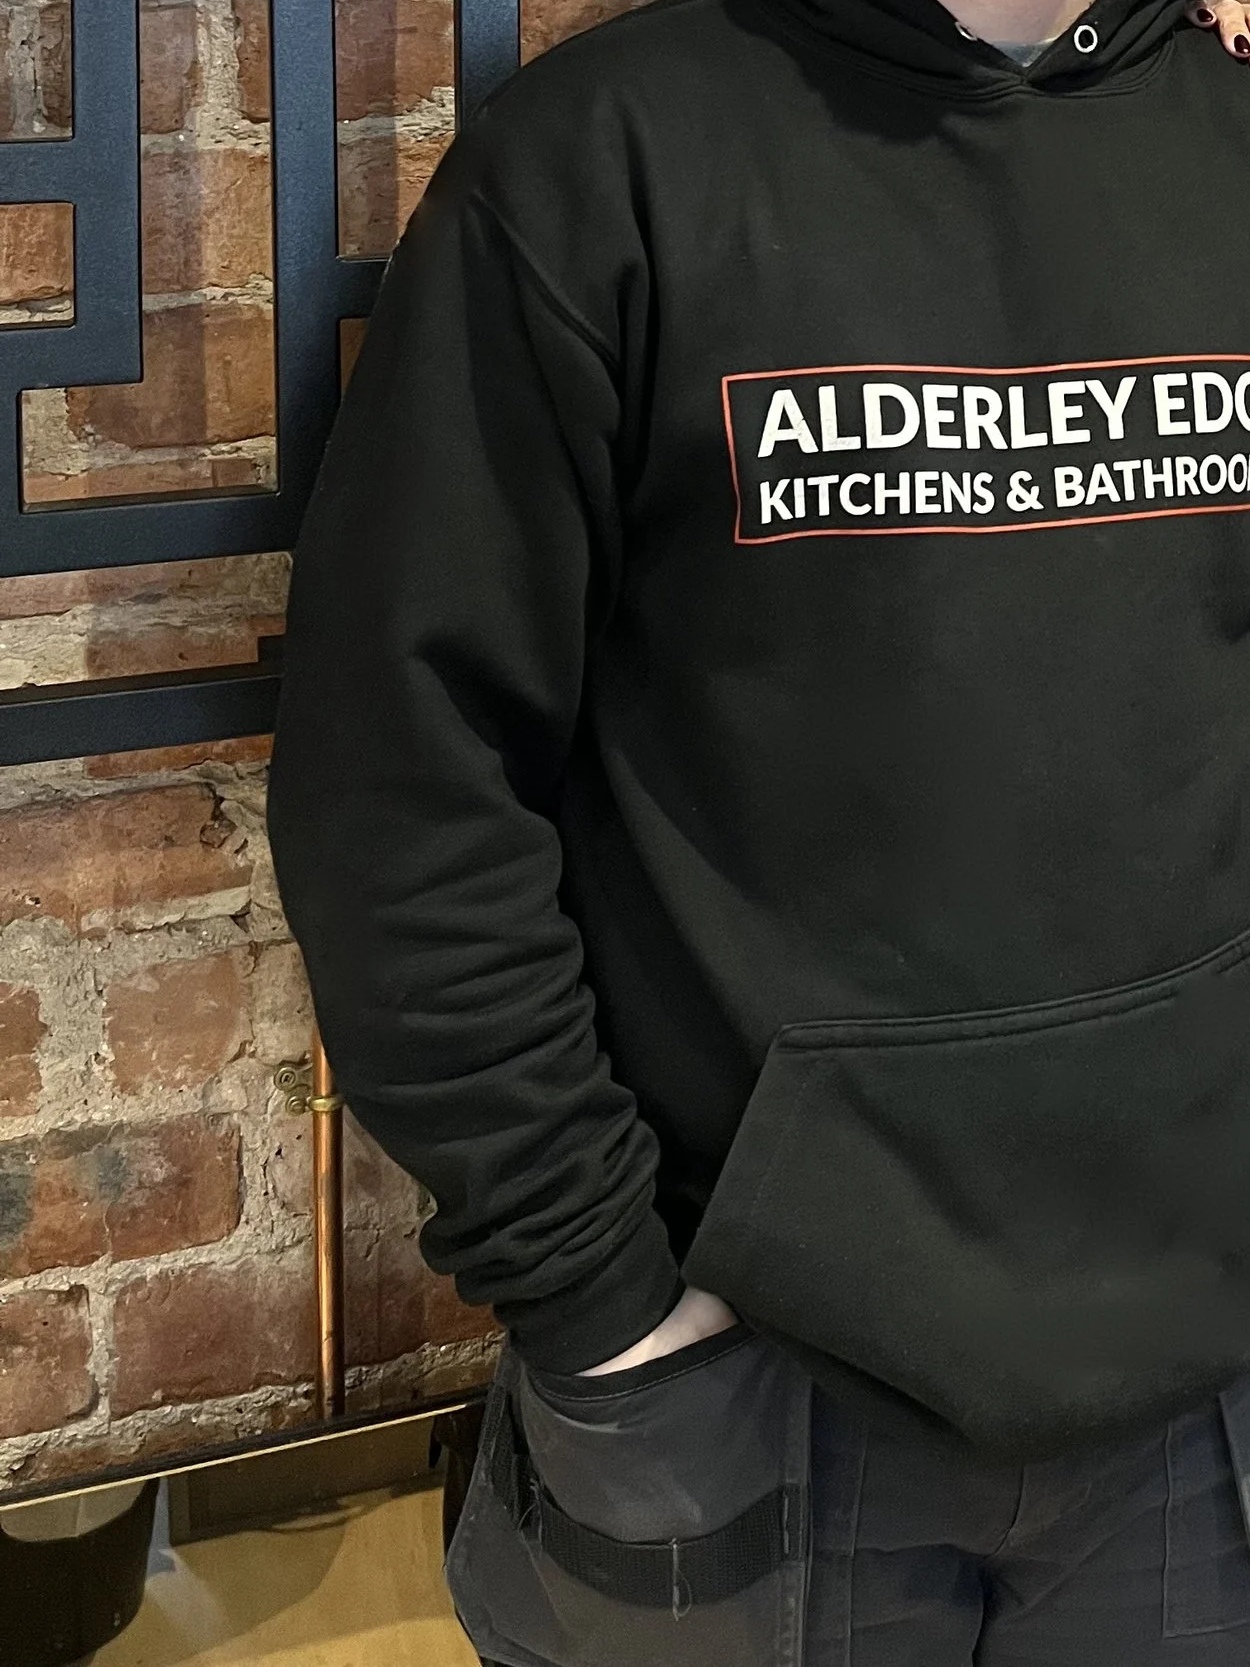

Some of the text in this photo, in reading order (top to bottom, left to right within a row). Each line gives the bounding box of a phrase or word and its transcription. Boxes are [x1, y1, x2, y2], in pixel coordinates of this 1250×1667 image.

[756, 376, 1137, 459] ALDERLEY
[758, 469, 996, 525] KITCHENS
[1005, 470, 1045, 513] &
